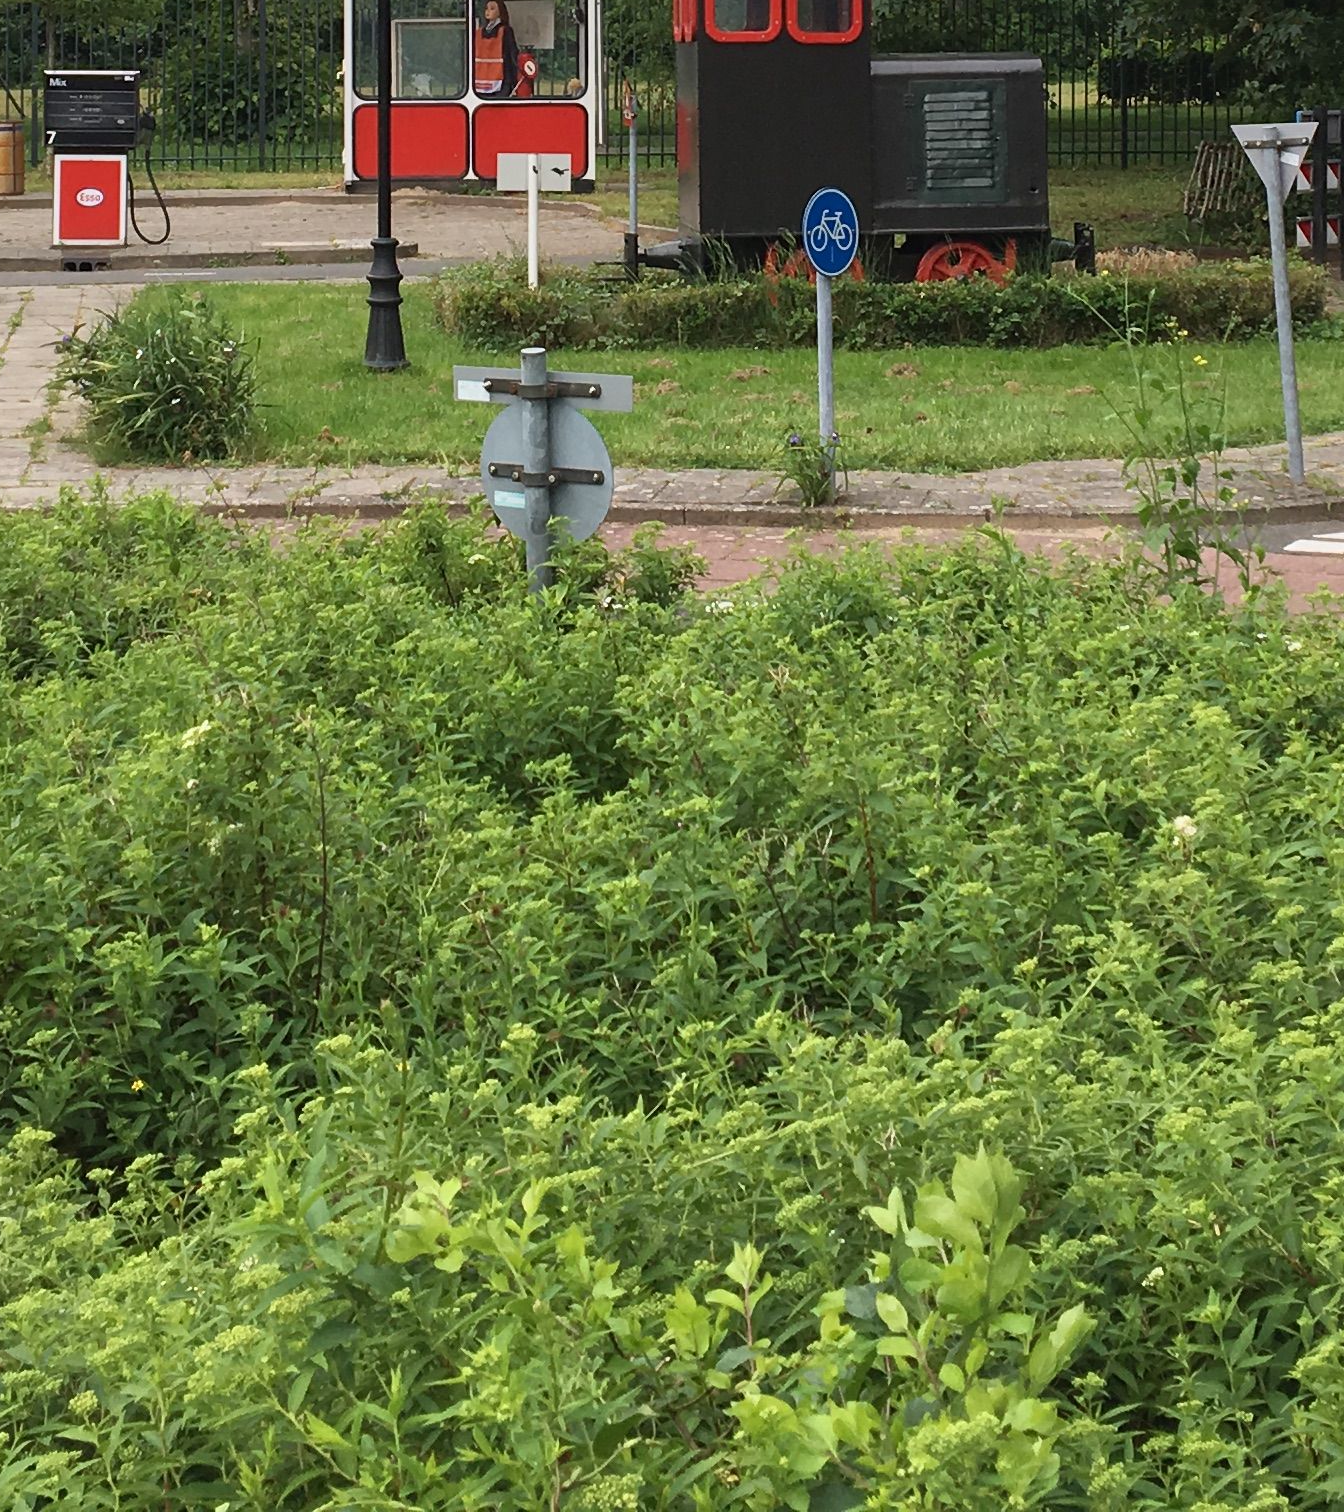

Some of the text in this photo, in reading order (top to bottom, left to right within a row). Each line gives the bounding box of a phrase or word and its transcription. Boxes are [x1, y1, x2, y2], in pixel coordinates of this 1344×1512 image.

[49, 77, 67, 87] Mix
[46, 131, 56, 145] 7
[79, 192, 101, 202] Esso
